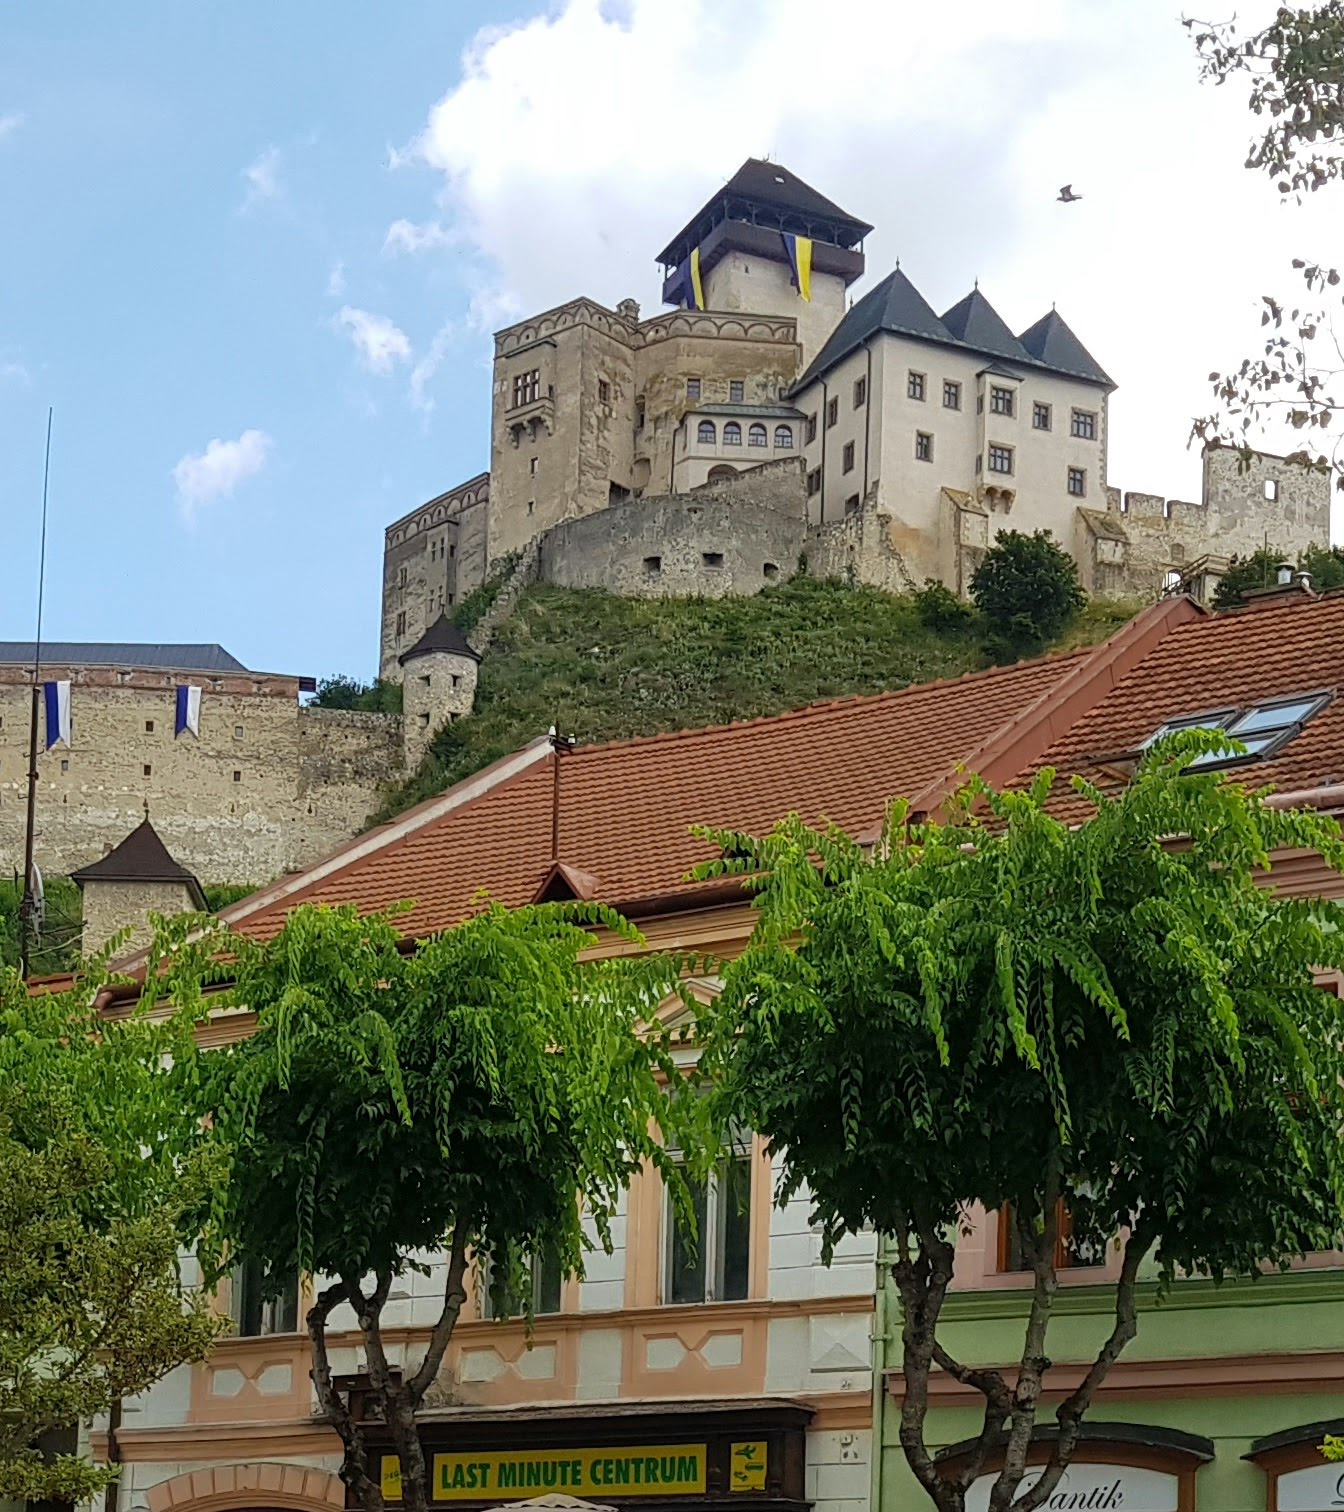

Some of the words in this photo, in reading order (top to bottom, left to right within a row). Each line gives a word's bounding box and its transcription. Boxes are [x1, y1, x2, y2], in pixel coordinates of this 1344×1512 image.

[441, 1463, 491, 1489] LAST
[497, 1459, 582, 1489] MINUTE
[589, 1455, 698, 1487] CENTRUM
